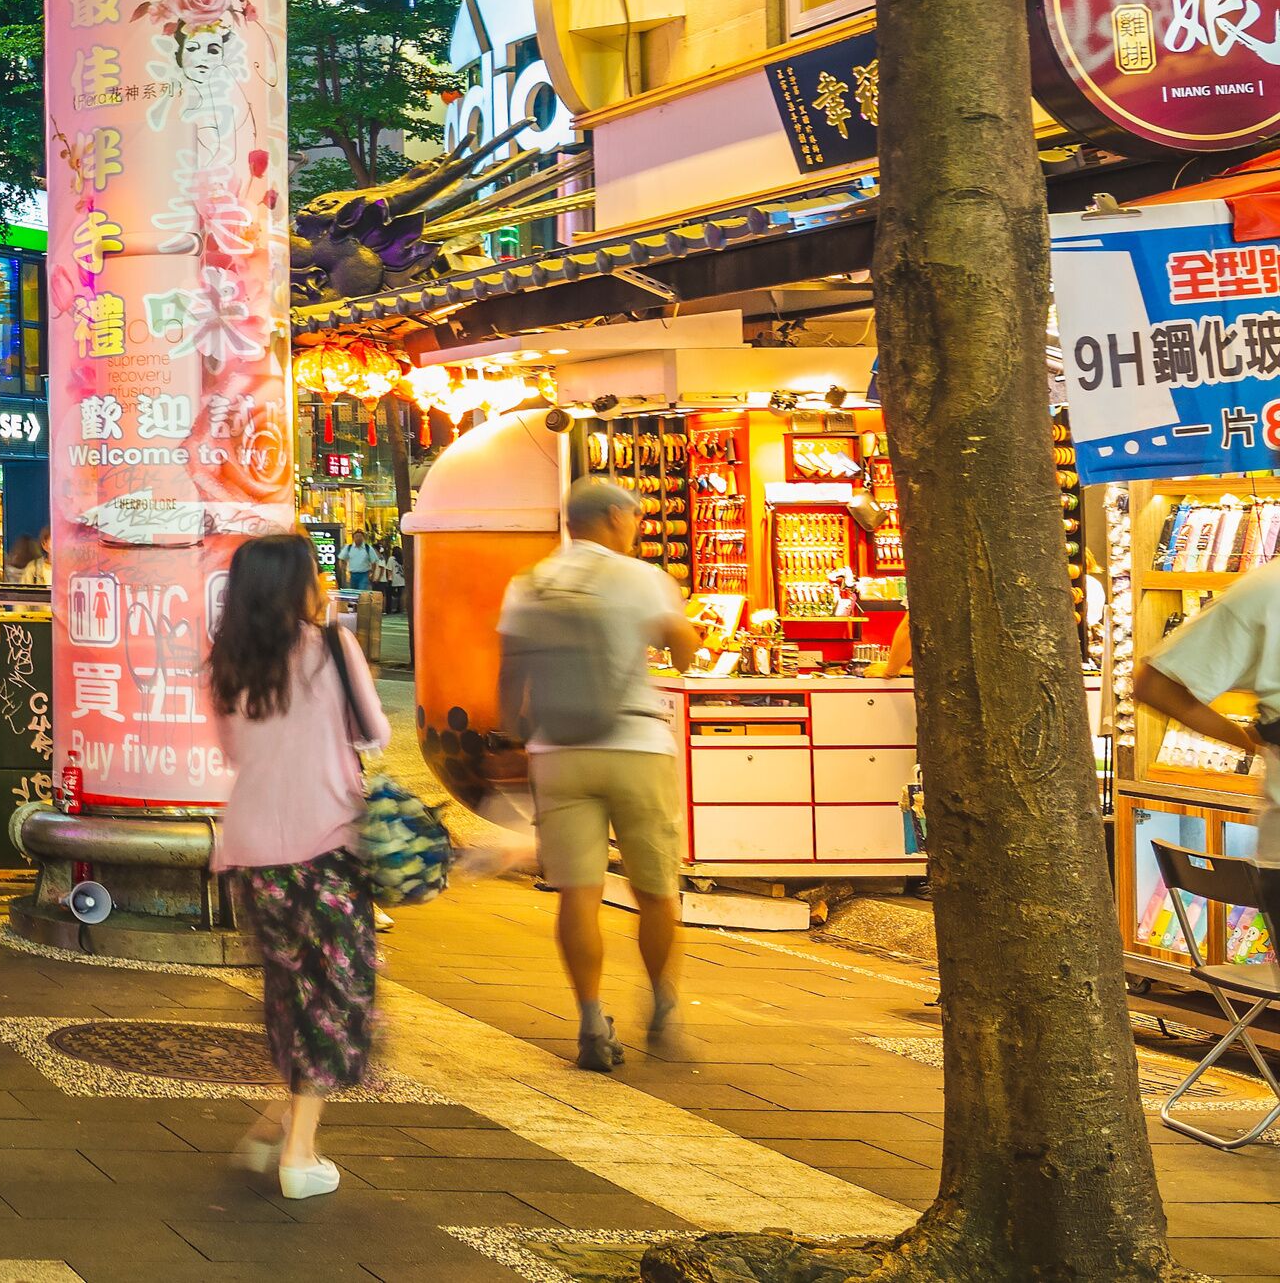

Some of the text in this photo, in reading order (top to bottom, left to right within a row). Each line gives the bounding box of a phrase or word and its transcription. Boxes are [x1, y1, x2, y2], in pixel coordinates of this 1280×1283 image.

[1121, 11, 1149, 67] 雞排
[1171, 81, 1255, 99] NIANG NIANG
[107, 354, 171, 369] supreme
[108, 371, 172, 385] recovery
[69, 445, 188, 467] Welcome
[125, 582, 189, 638] WC
[72, 730, 114, 781] Buy
[121, 733, 177, 778] five
